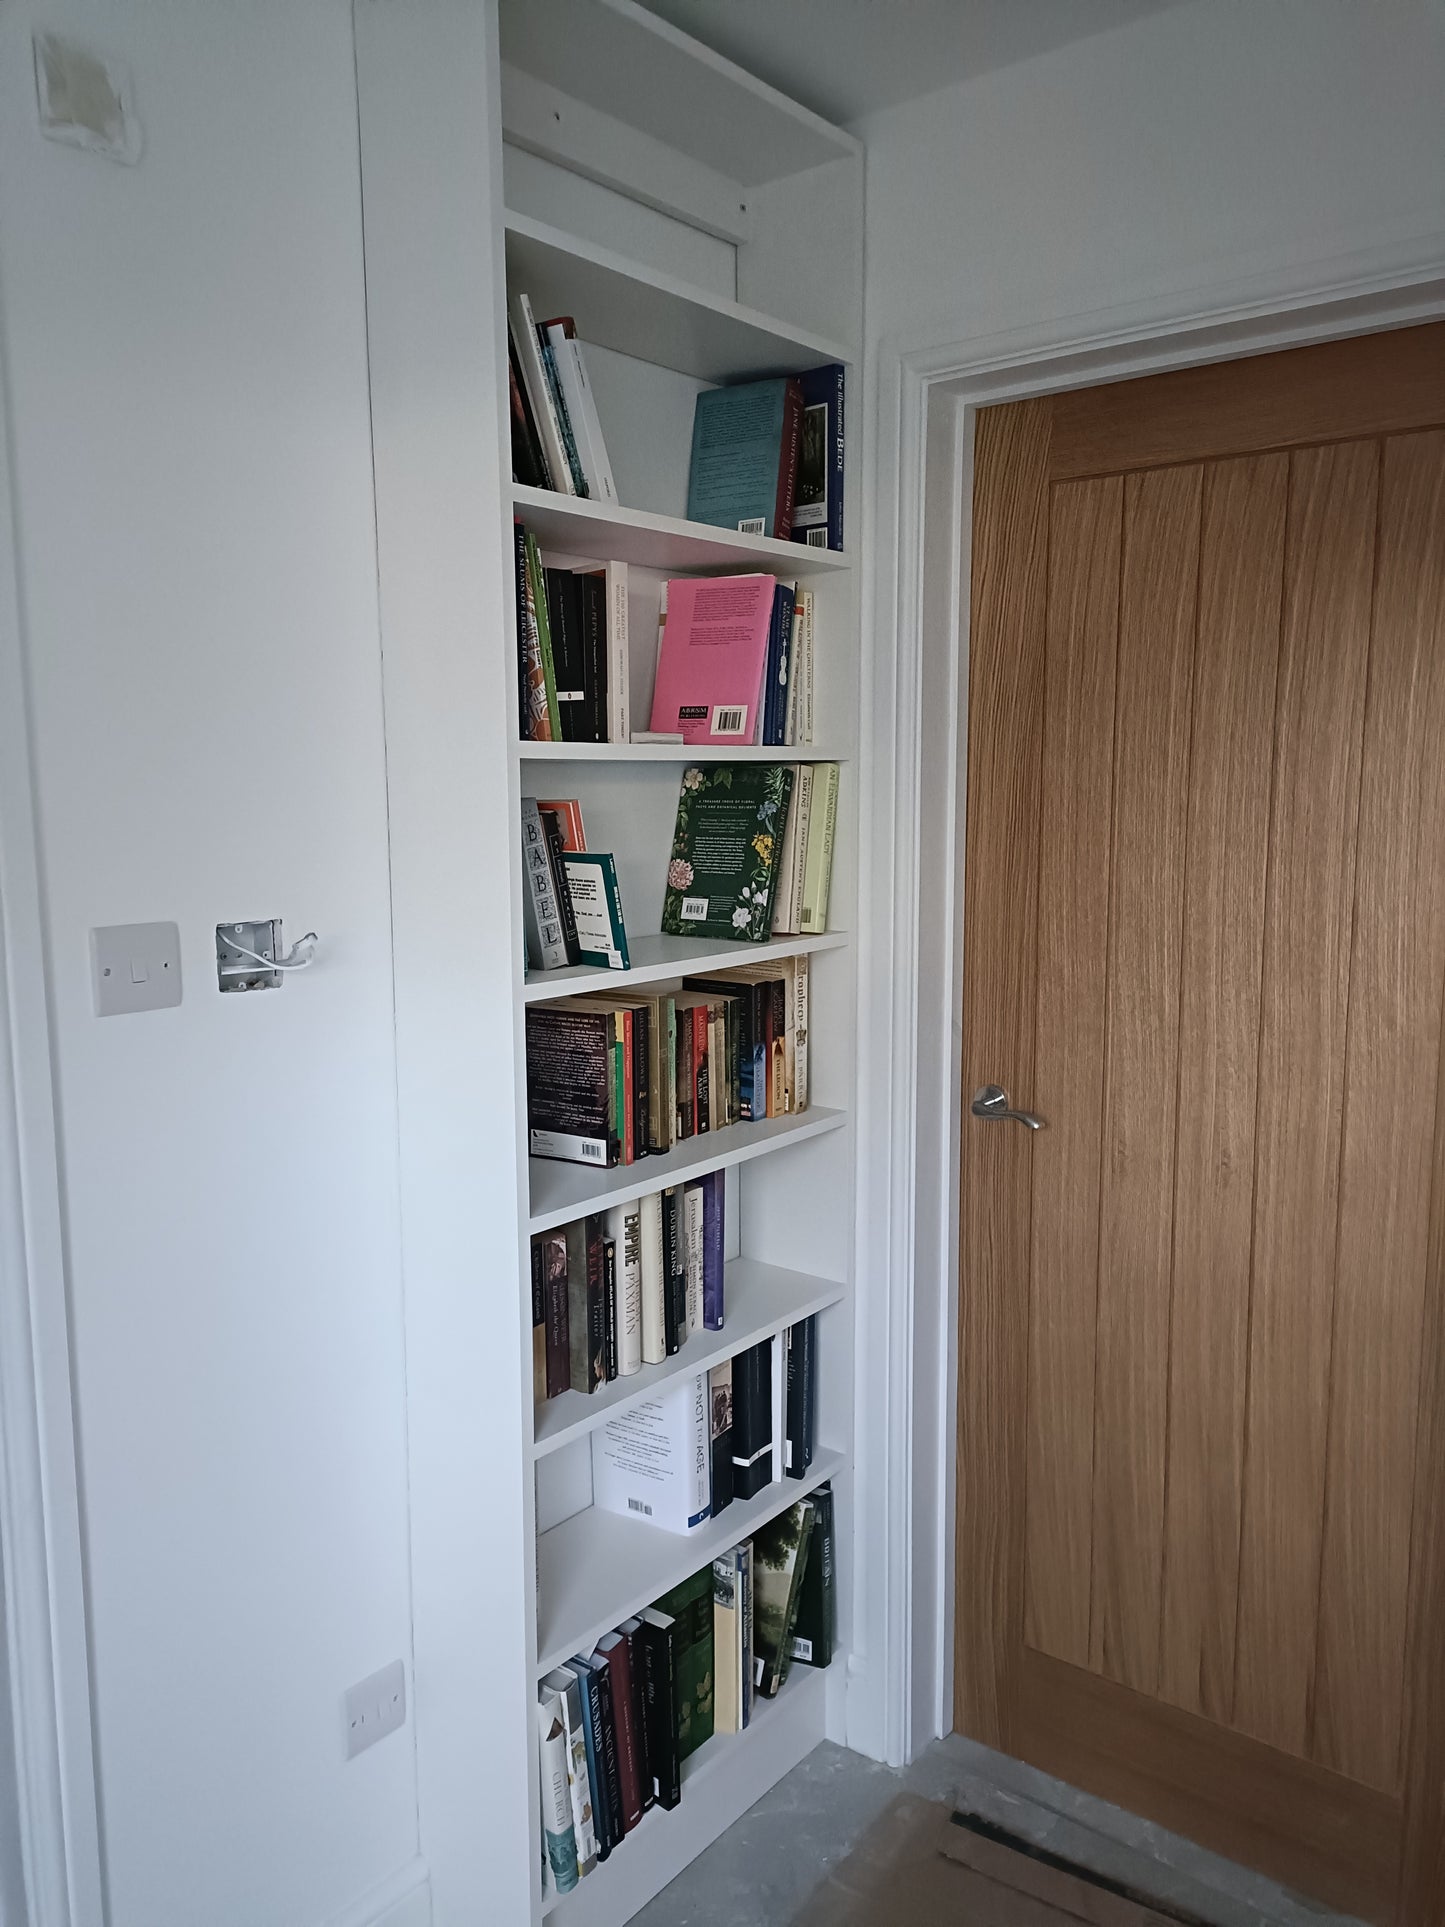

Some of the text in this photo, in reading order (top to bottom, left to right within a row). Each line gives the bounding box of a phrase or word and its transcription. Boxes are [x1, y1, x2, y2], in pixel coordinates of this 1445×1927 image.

[785, 473, 793, 512] LETTERS
[520, 594, 527, 608] OF
[829, 768, 836, 780] AN
[824, 783, 836, 831] EDWARDIAN
[528, 824, 558, 944] BABEL
[625, 1212, 639, 1267] EMPIRE
[689, 1198, 698, 1250] Jerusalem
[589, 1242, 598, 1286] WEIR
[626, 1272, 635, 1336] PAXMAN
[590, 1686, 603, 1752] CRUSADES
[604, 1724, 615, 1774] ANCIENT
[551, 1771, 565, 1827] CHURCH
